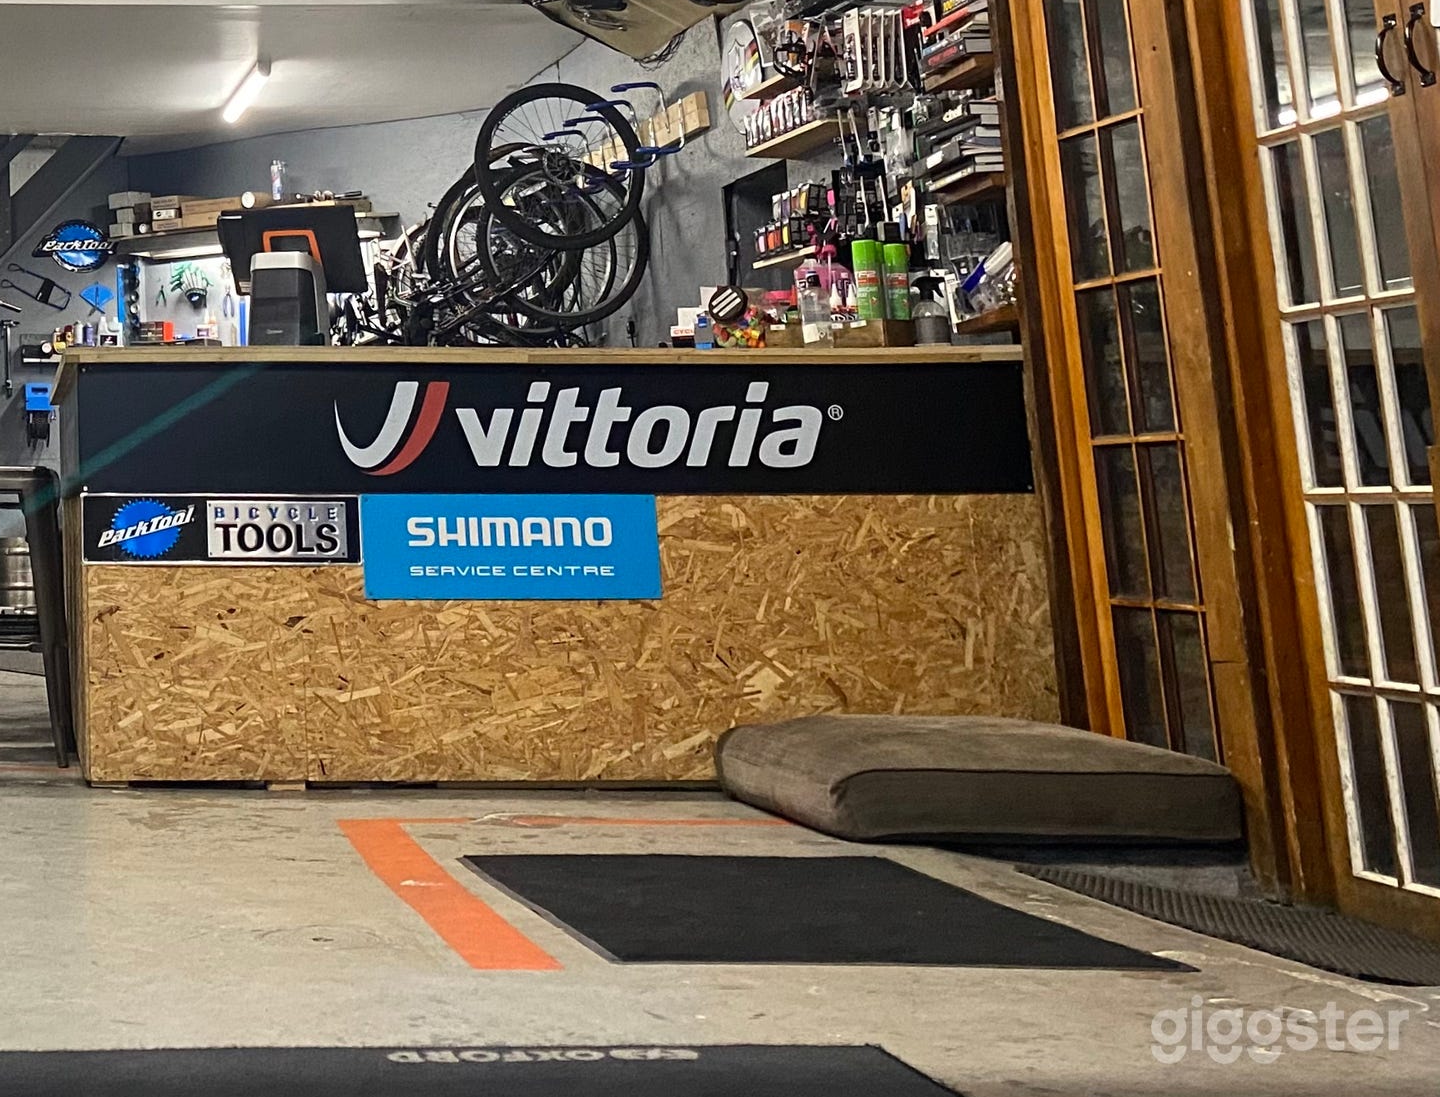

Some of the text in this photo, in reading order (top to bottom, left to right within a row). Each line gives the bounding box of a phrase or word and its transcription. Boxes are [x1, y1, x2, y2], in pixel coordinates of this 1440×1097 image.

[214, 506, 339, 521] BICYCLE
[214, 522, 340, 553] TOOLS
[406, 516, 613, 547] SHIMANO
[409, 565, 616, 576] SERVICE CENTRE
